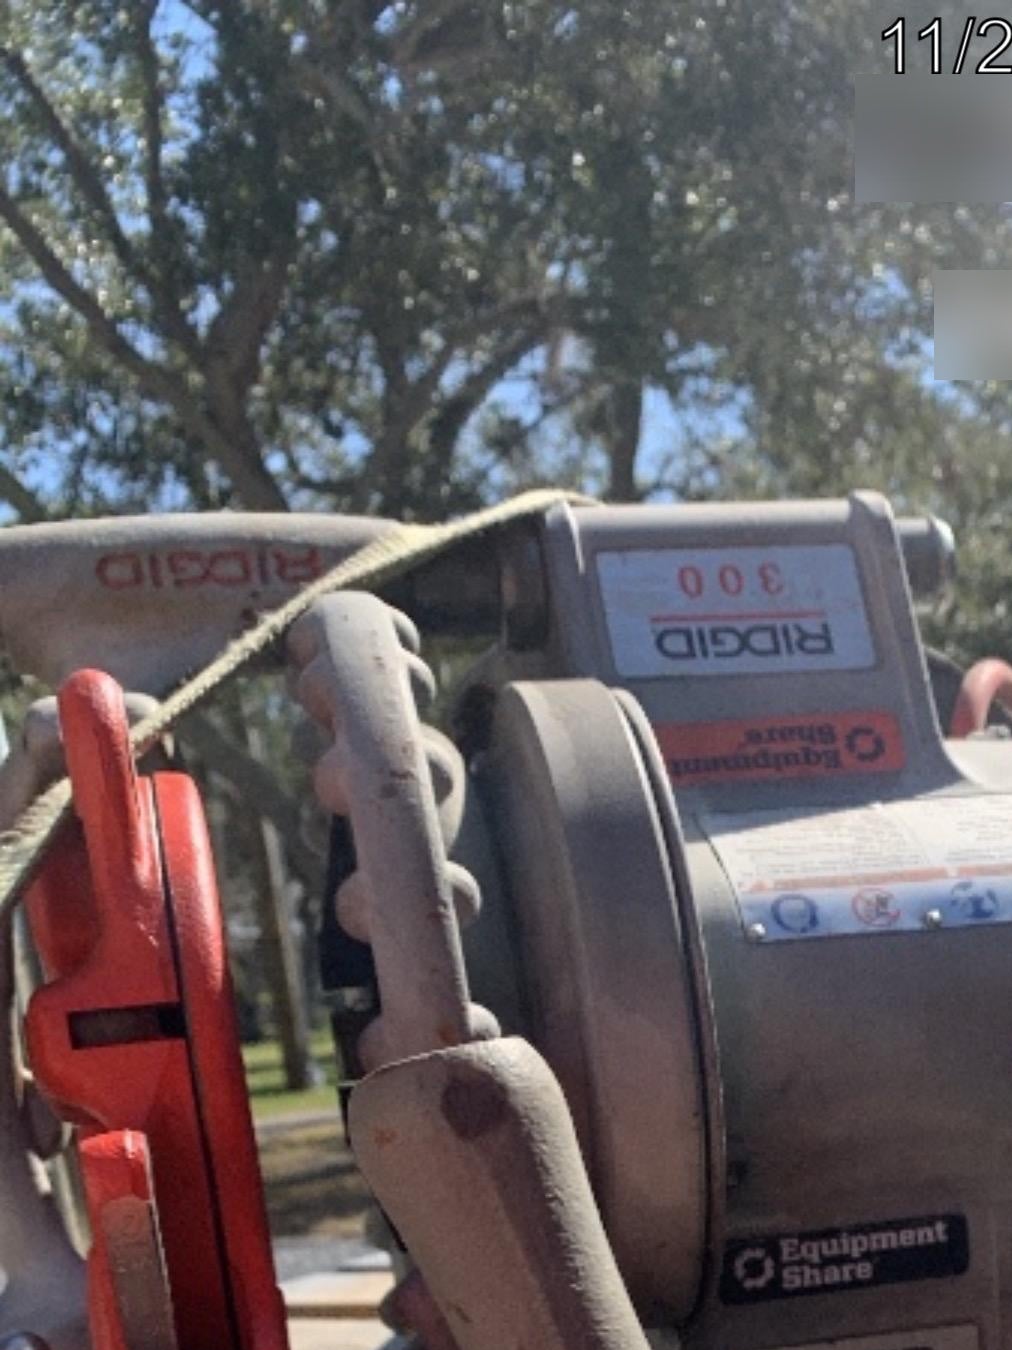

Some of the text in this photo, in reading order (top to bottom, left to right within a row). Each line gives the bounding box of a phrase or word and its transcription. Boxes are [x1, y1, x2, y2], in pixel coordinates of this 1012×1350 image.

[95, 546, 323, 590] RIDGID
[676, 561, 785, 599] 300
[655, 621, 836, 661] RIDGID
[743, 722, 838, 747] Share
[669, 744, 843, 777] Equipment
[779, 1219, 950, 1264] Equipment
[781, 1257, 875, 1291] Share
